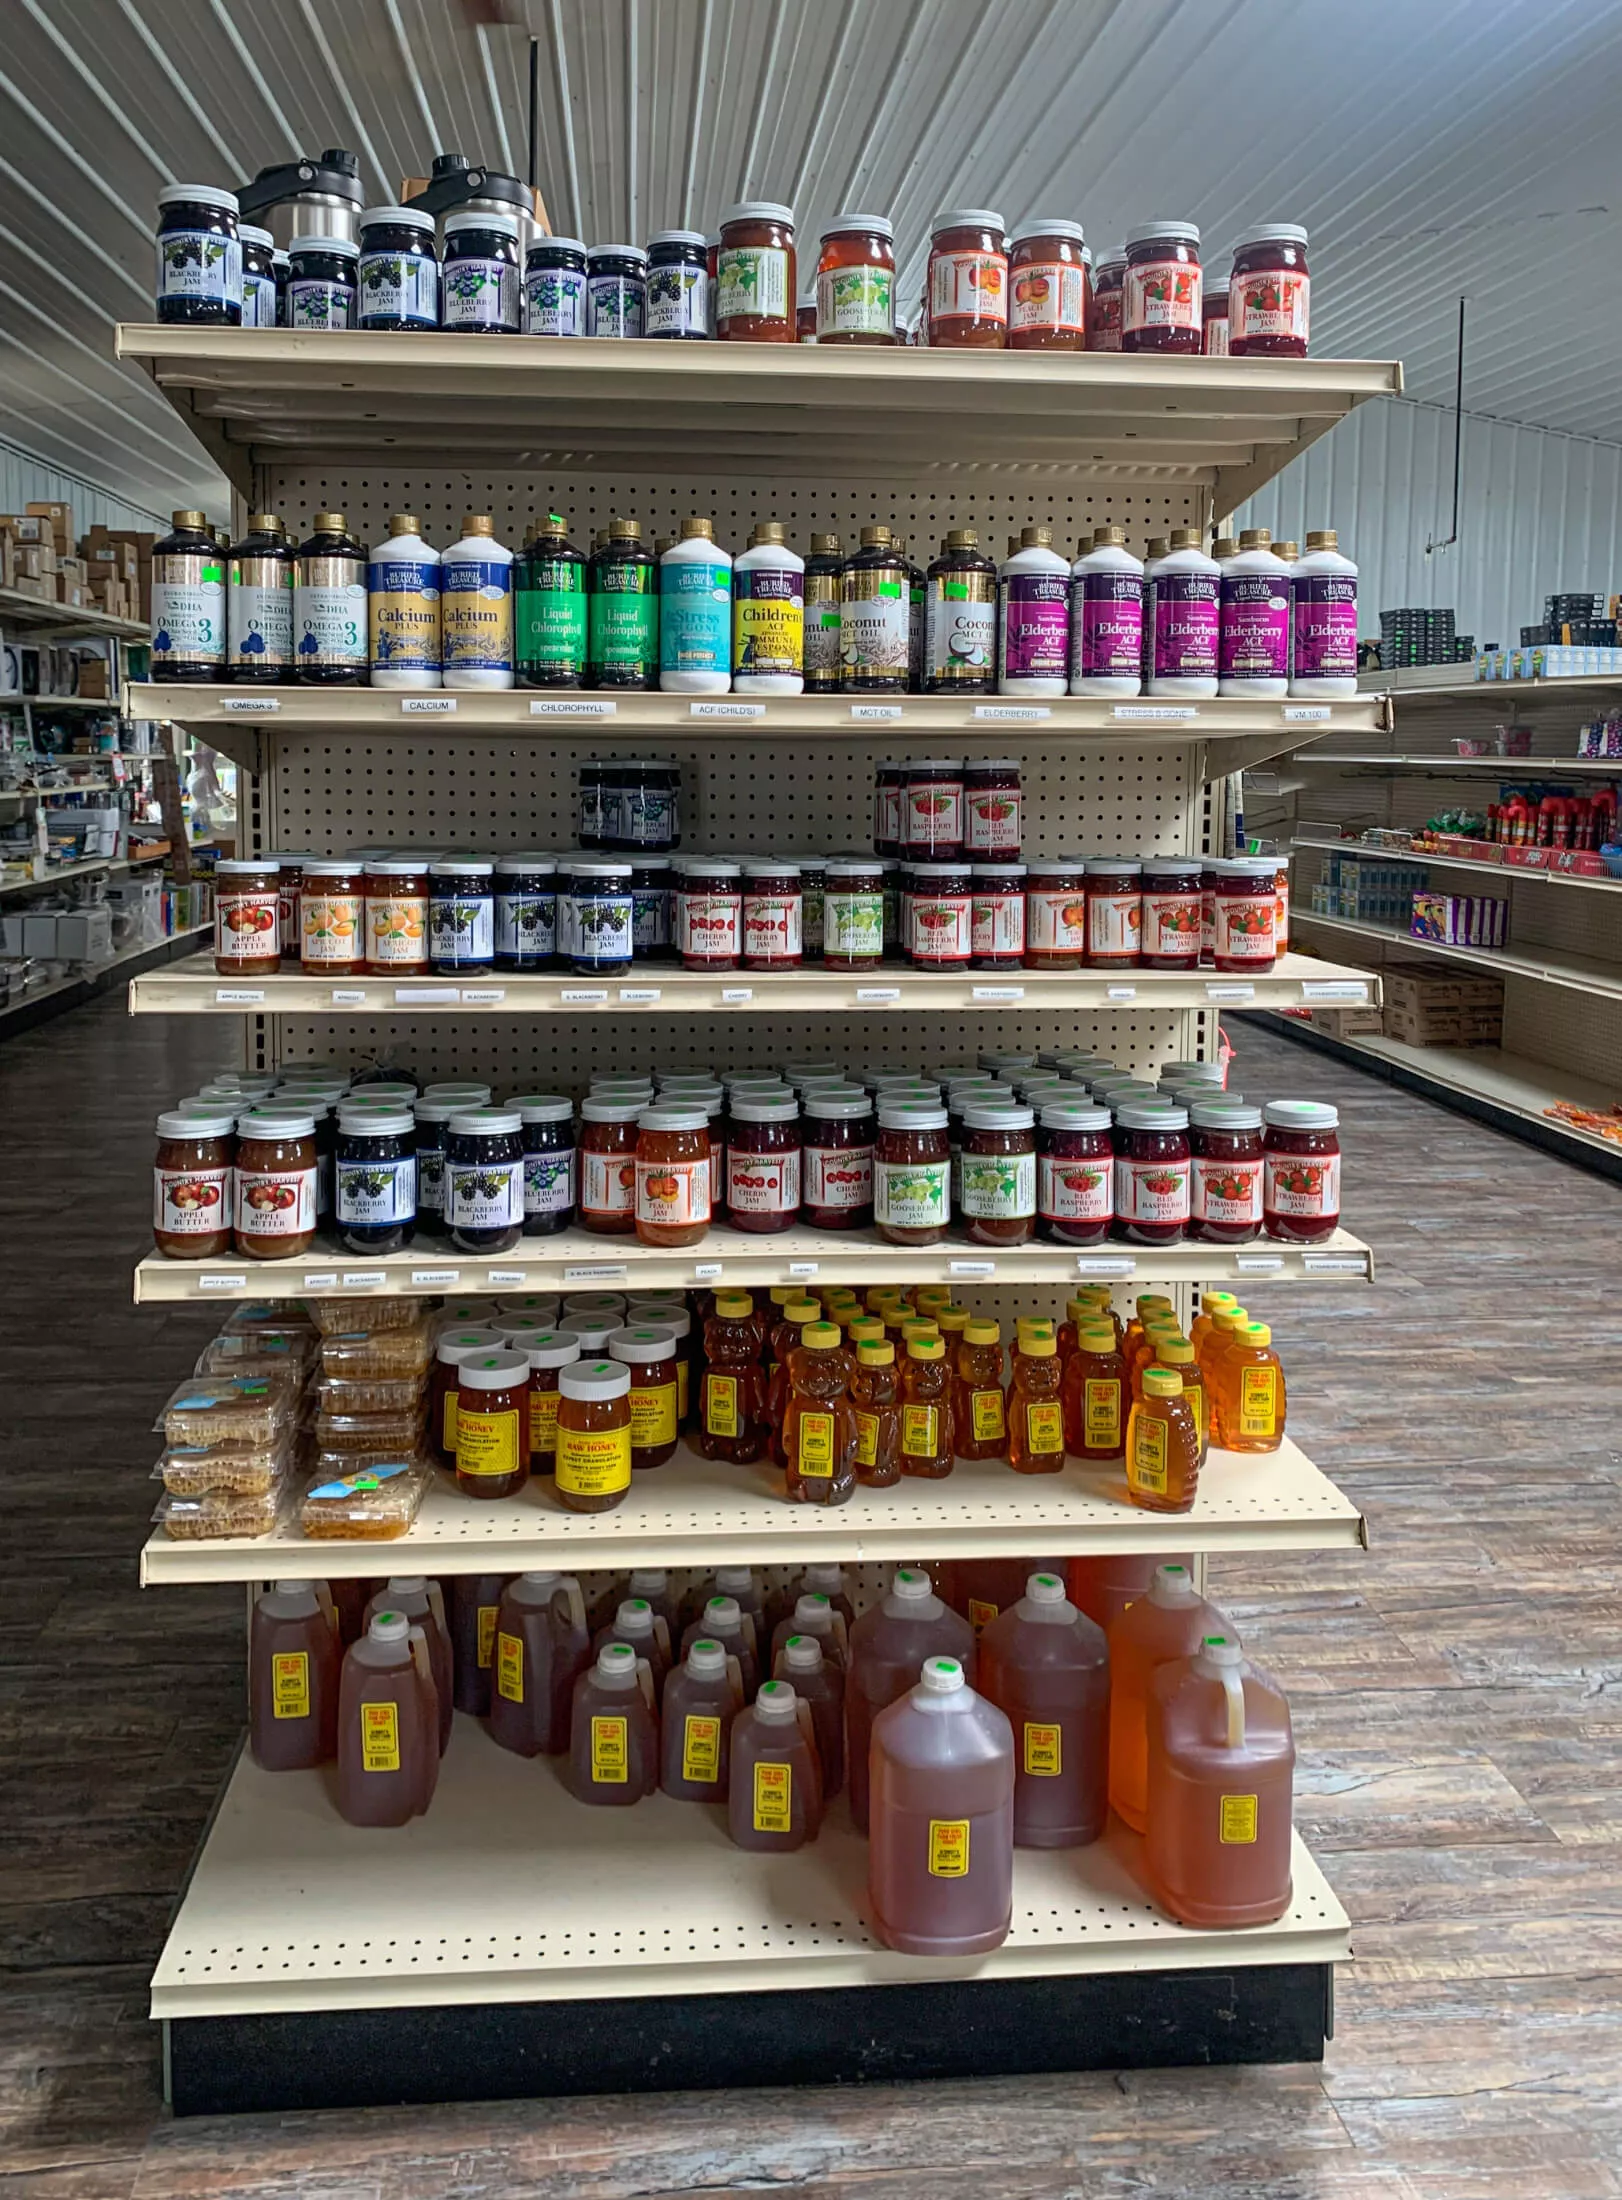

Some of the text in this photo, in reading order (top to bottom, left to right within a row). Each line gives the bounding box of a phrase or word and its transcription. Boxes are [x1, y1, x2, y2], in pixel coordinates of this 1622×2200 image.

[168, 270, 217, 281] BLACKBERY
[274, 606, 292, 616] DH
[377, 607, 436, 624] Calcium
[443, 607, 498, 624] Calcium
[543, 607, 573, 624] Liquid
[607, 608, 638, 625] Liquid
[247, 620, 289, 633] OMEGA
[394, 622, 420, 630] PLUS
[454, 622, 479, 630] PLUS
[954, 616, 994, 630] Cocon
[157, 616, 213, 643] OMEGA 3
[303, 619, 358, 646] OMEGA 3
[598, 623, 649, 640] Chlorophyll
[1021, 623, 1070, 636] Elderber
[1099, 624, 1142, 637] Elderbe
[1170, 623, 1219, 636] Elderber
[1224, 625, 1283, 640] Elderberry
[1310, 624, 1357, 637] Elderber
[231, 701, 265, 710] OMEGA
[409, 701, 450, 710] CALCIUM
[540, 704, 605, 713] CHLOROPHYLL
[699, 705, 716, 714] ACF
[860, 708, 894, 717] MCT OIL
[983, 709, 1038, 718] ELDERBERRY
[250, 898, 277, 907] HARVE
[235, 935, 262, 944] APPLE
[532, 937, 547, 946] JAM
[1161, 934, 1200, 943] STRAWBER
[231, 942, 267, 951] BUTTER
[599, 941, 615, 950] JAM
[537, 1196, 553, 1204] JAM
[744, 1197, 760, 1206] JAM
[842, 1193, 859, 1202] JAM
[978, 1201, 995, 1210] JAM
[1290, 1200, 1305, 1210] JAM
[177, 1210, 205, 1219] APPLE
[354, 1206, 371, 1215] JAM
[653, 1208, 668, 1218] JAM
[1074, 1206, 1091, 1215] JAM
[1157, 1208, 1172, 1217] JAM
[1222, 1208, 1237, 1217] JAM
[253, 1212, 280, 1220] APPLE
[471, 1212, 488, 1222] JAM
[908, 1211, 924, 1220] JAM
[173, 1217, 210, 1226] BUTTER
[249, 1218, 286, 1228] BUTTER
[466, 1423, 494, 1433] HONEY
[567, 1442, 617, 1453] RAW HONEY
